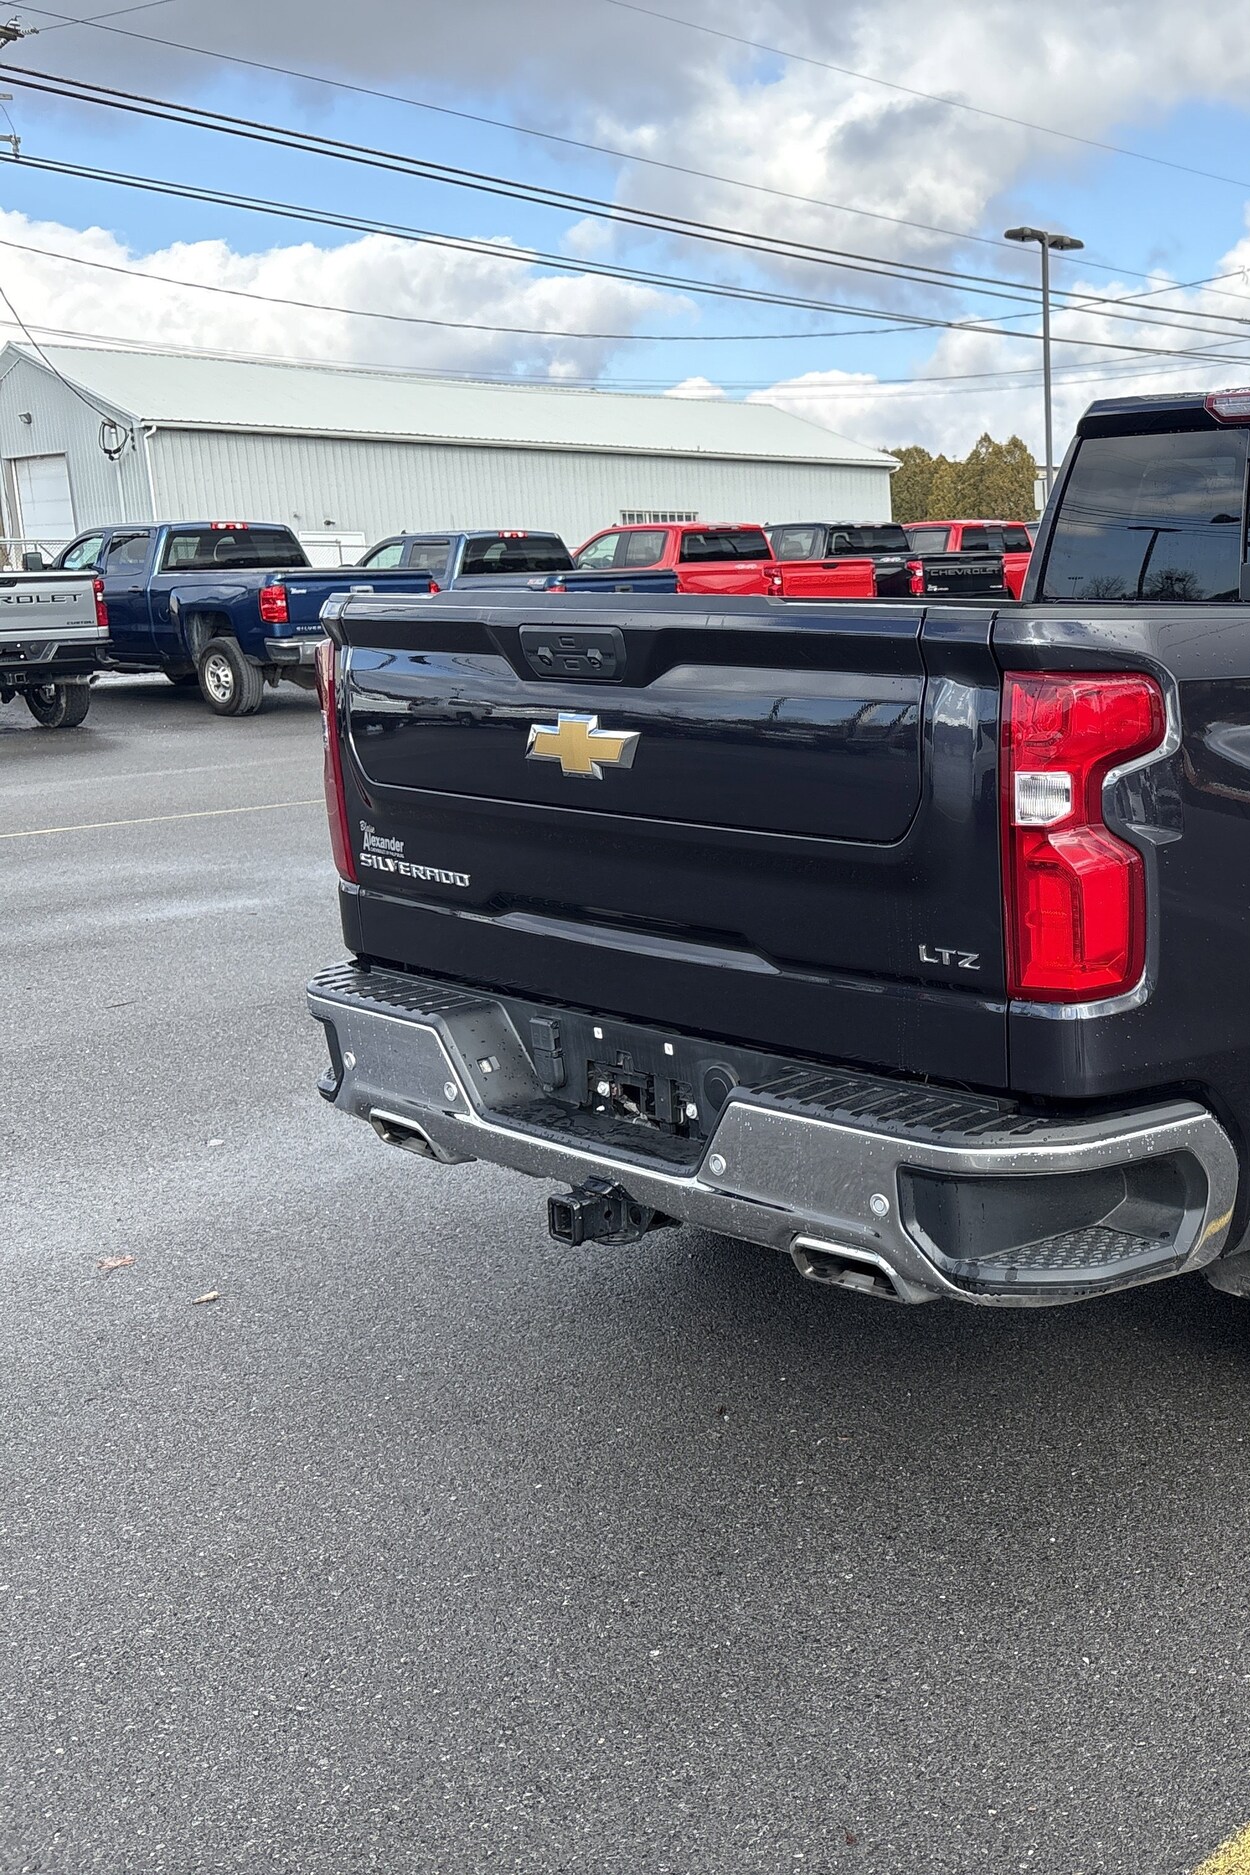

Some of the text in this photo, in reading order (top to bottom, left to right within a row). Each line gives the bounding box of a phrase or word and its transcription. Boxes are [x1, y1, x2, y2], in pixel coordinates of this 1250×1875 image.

[930, 567, 1000, 576] CHEVROLET
[363, 832, 404, 853] Alexander
[360, 852, 470, 887] SILVERADO
[919, 944, 980, 970] LTZ
